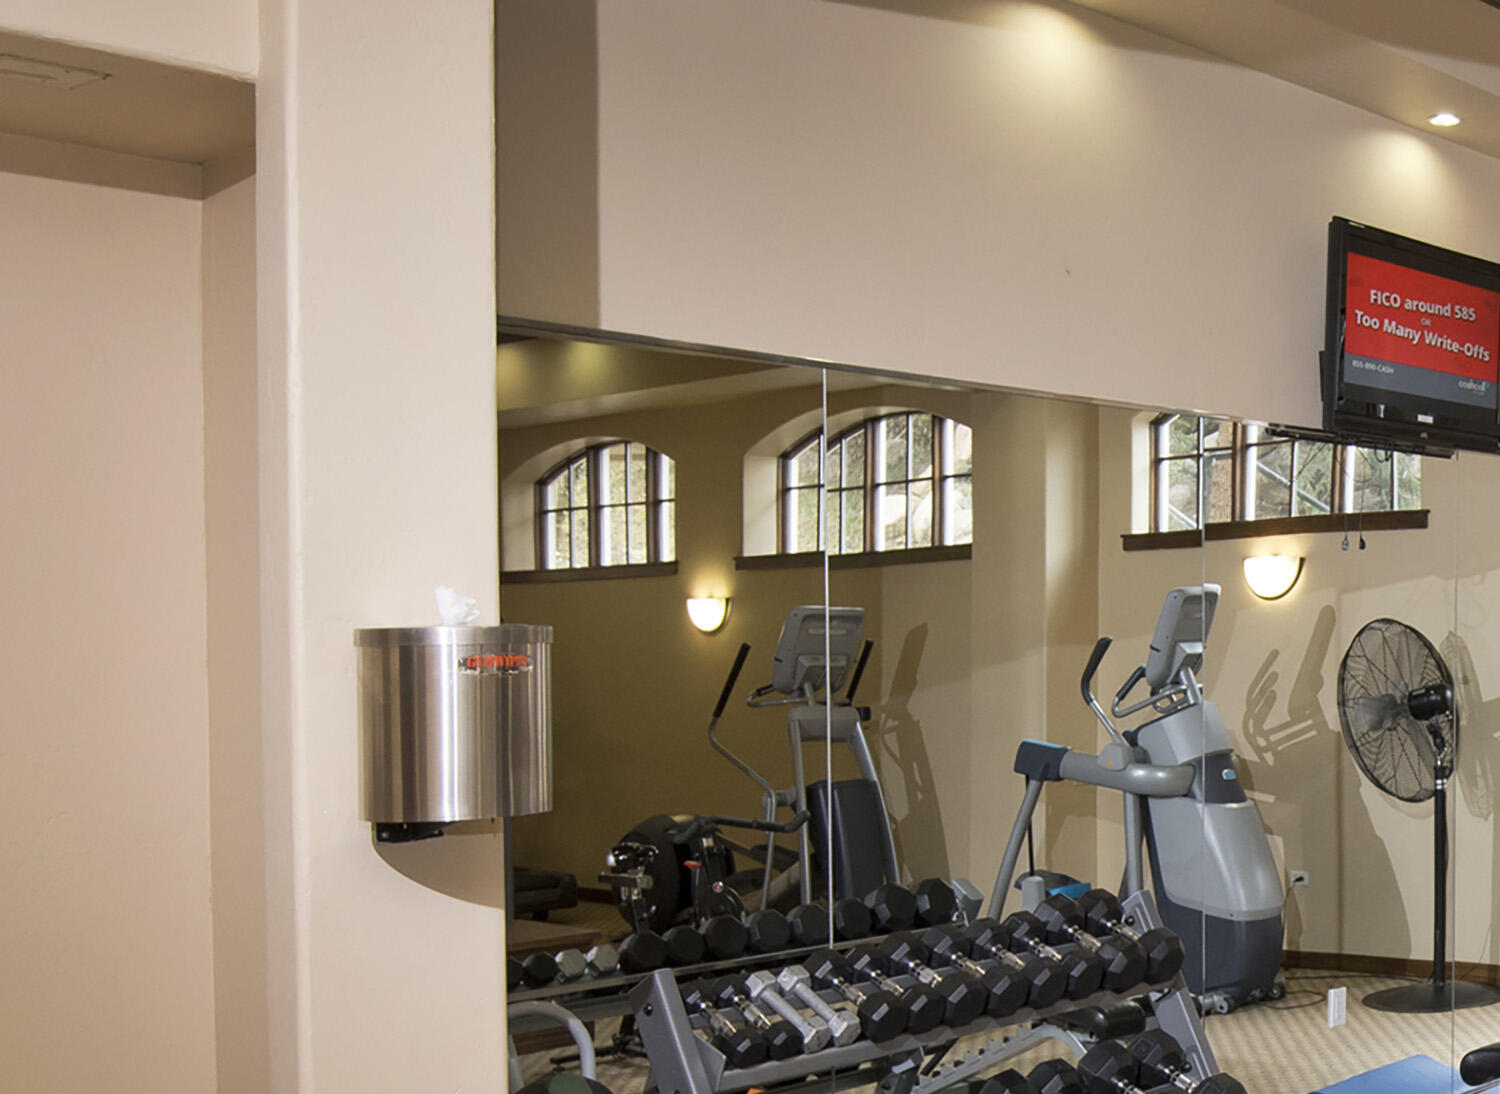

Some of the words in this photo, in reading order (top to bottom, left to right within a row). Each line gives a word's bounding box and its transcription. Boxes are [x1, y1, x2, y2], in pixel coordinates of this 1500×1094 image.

[1369, 289, 1401, 308] FICO
[1404, 298, 1451, 317] around
[1454, 305, 1476, 321] 585
[1354, 310, 1380, 330] Too
[1383, 318, 1421, 345] Many
[1424, 331, 1490, 362] Write-Offs
